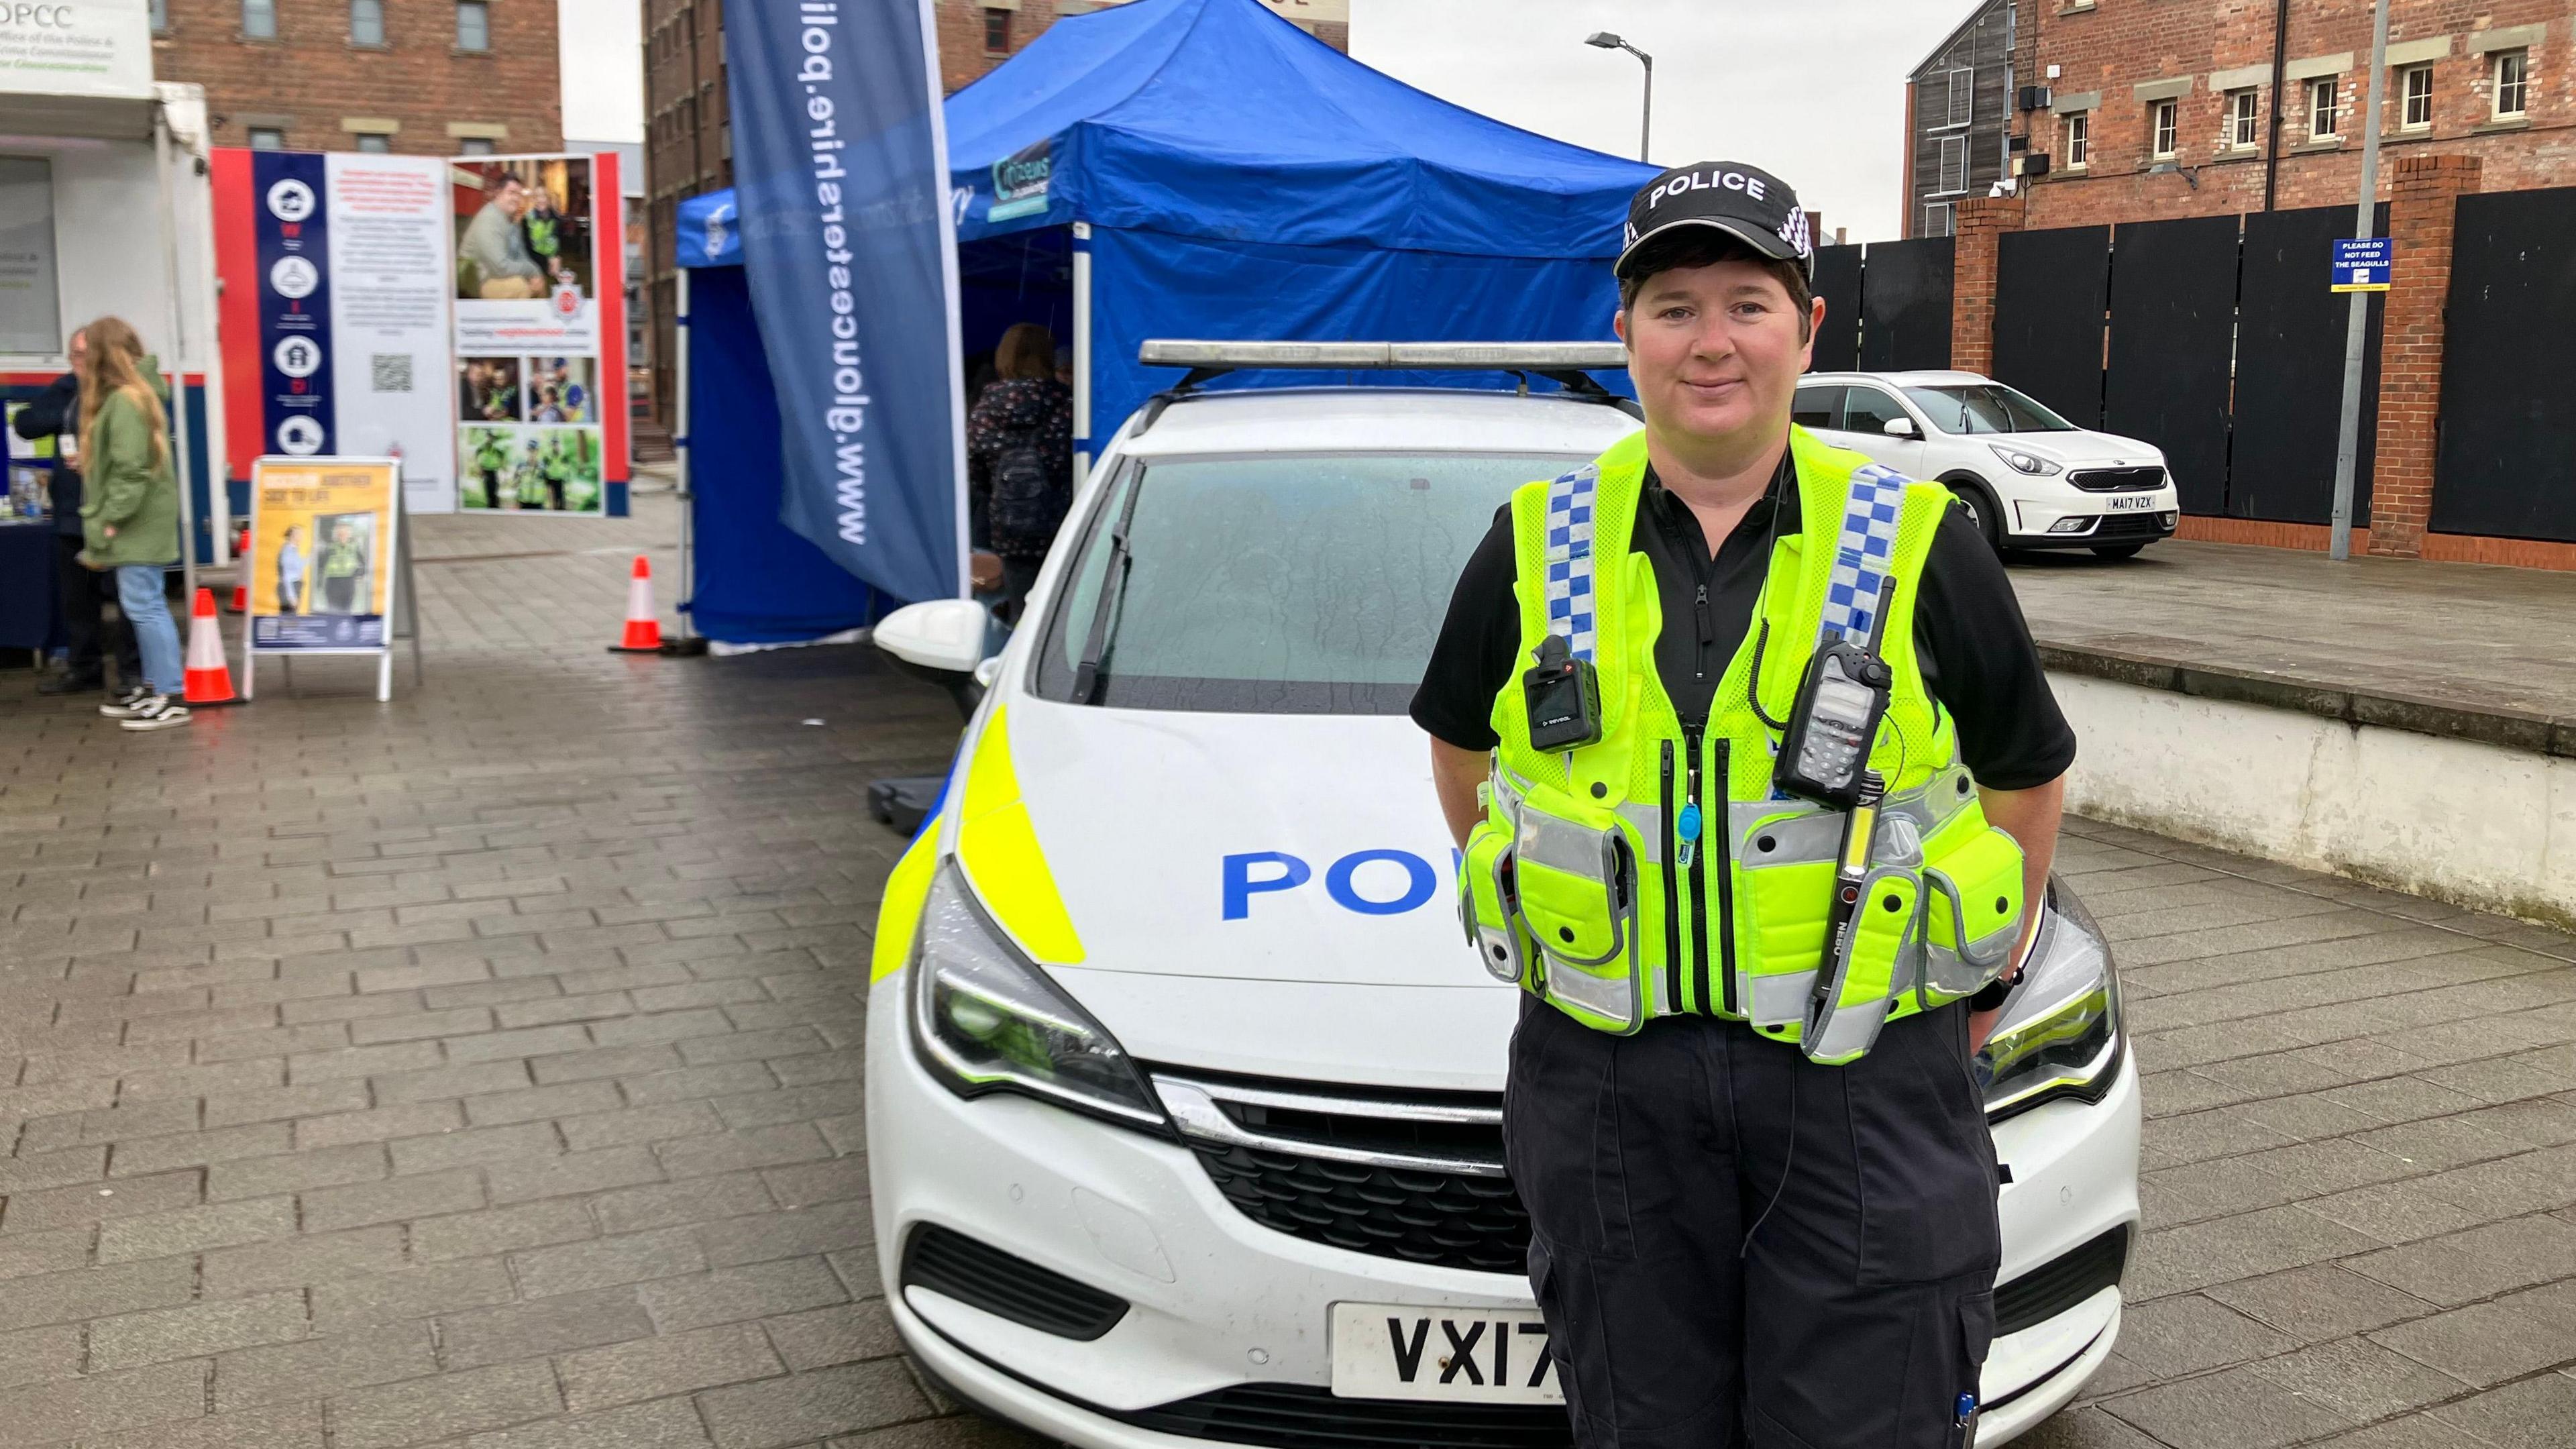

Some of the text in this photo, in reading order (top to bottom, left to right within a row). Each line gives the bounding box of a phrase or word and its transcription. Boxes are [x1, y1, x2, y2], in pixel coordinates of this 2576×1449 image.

[1649, 170, 1765, 209] POLICE
[2112, 497, 2151, 509] MA17 VZX
[1222, 847, 1461, 921] PO
[1833, 921, 1847, 956] NEBO
[1387, 1318, 1553, 1387] VX17
